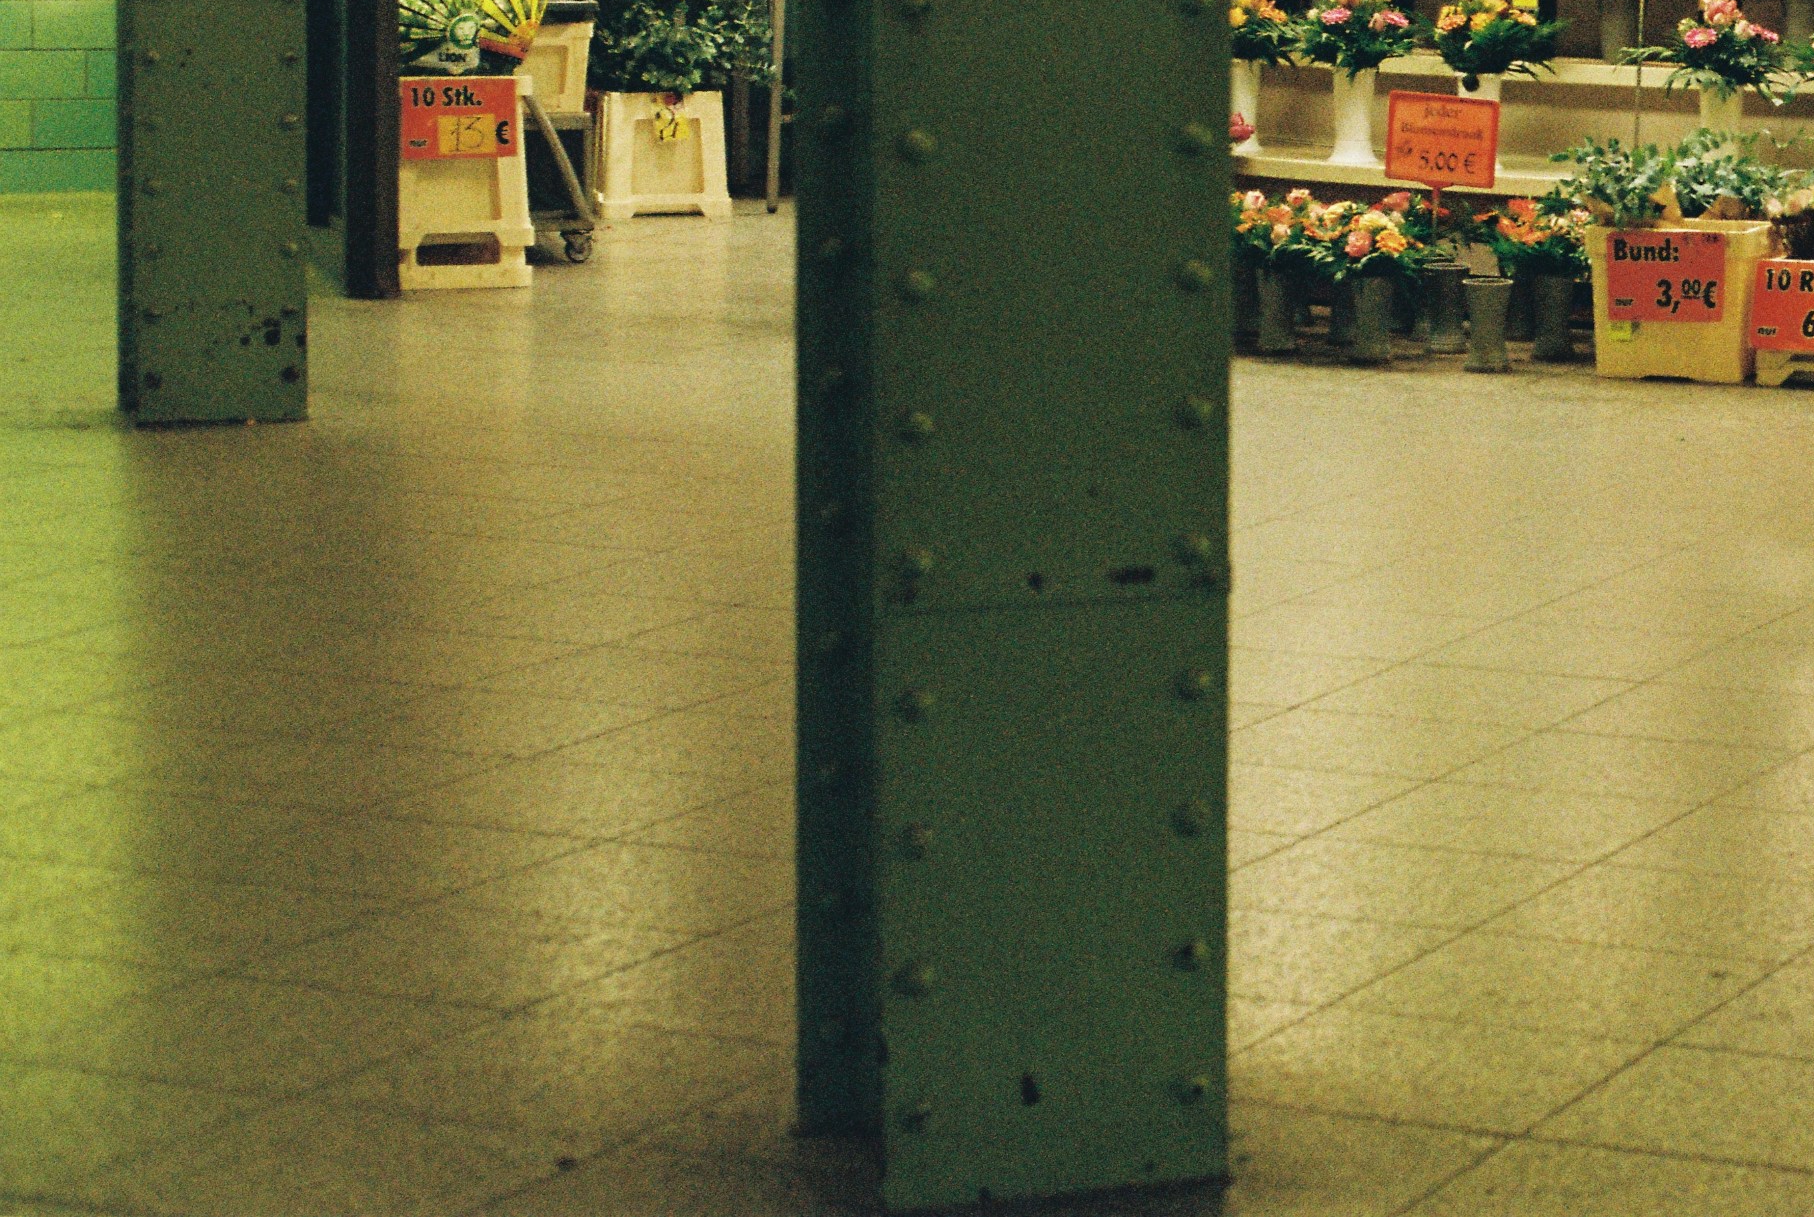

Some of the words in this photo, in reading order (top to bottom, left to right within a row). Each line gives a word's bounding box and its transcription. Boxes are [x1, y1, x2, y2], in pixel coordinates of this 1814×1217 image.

[411, 87, 436, 107] 10
[442, 85, 483, 107] Stk.
[496, 120, 510, 145] €
[1614, 238, 1679, 262] Bund:
[1766, 269, 1791, 291] 10
